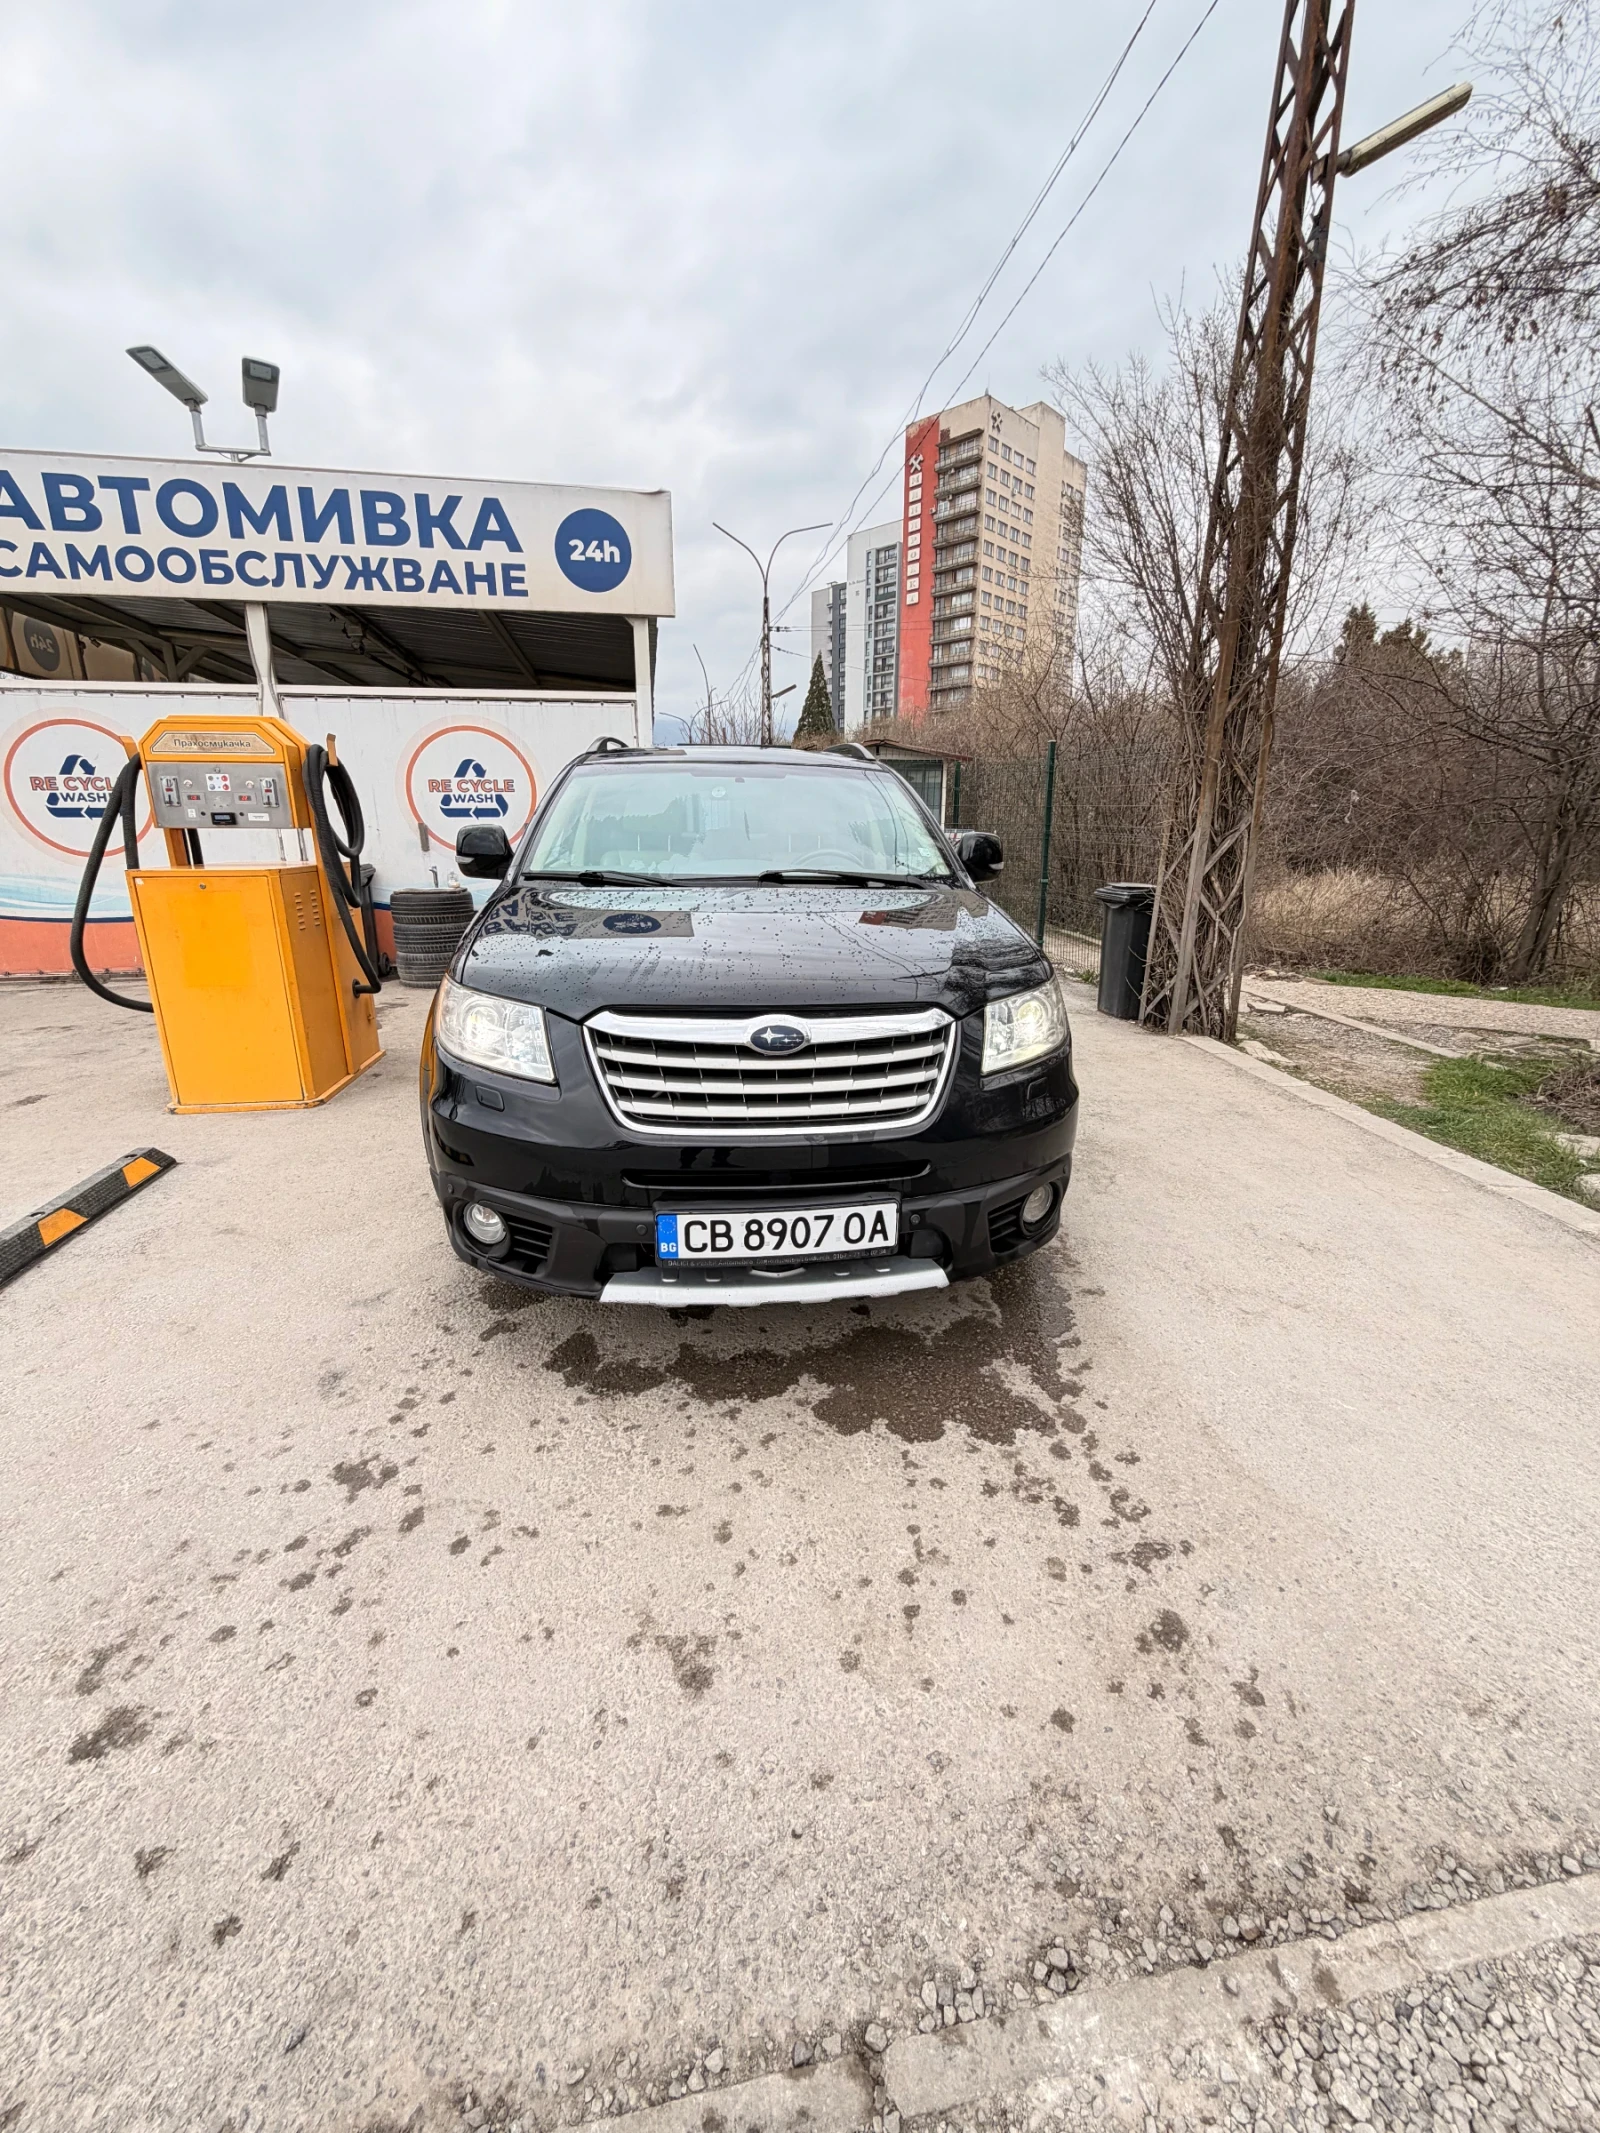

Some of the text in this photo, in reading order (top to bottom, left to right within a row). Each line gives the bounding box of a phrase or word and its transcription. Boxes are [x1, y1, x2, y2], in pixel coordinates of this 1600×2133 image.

[0, 470, 524, 554] АВТОМИВКА
[568, 539, 621, 563] 24h
[0, 539, 529, 597] САМООБСЛУЖВАНЕ
[173, 738, 251, 748] Прахосмукачка
[29, 776, 114, 791] RE CYCL
[428, 779, 515, 793] RE CYCLE
[60, 792, 108, 802] WASH
[453, 794, 494, 803] WASH
[660, 1210, 889, 1252] BG CB 8907 OA
